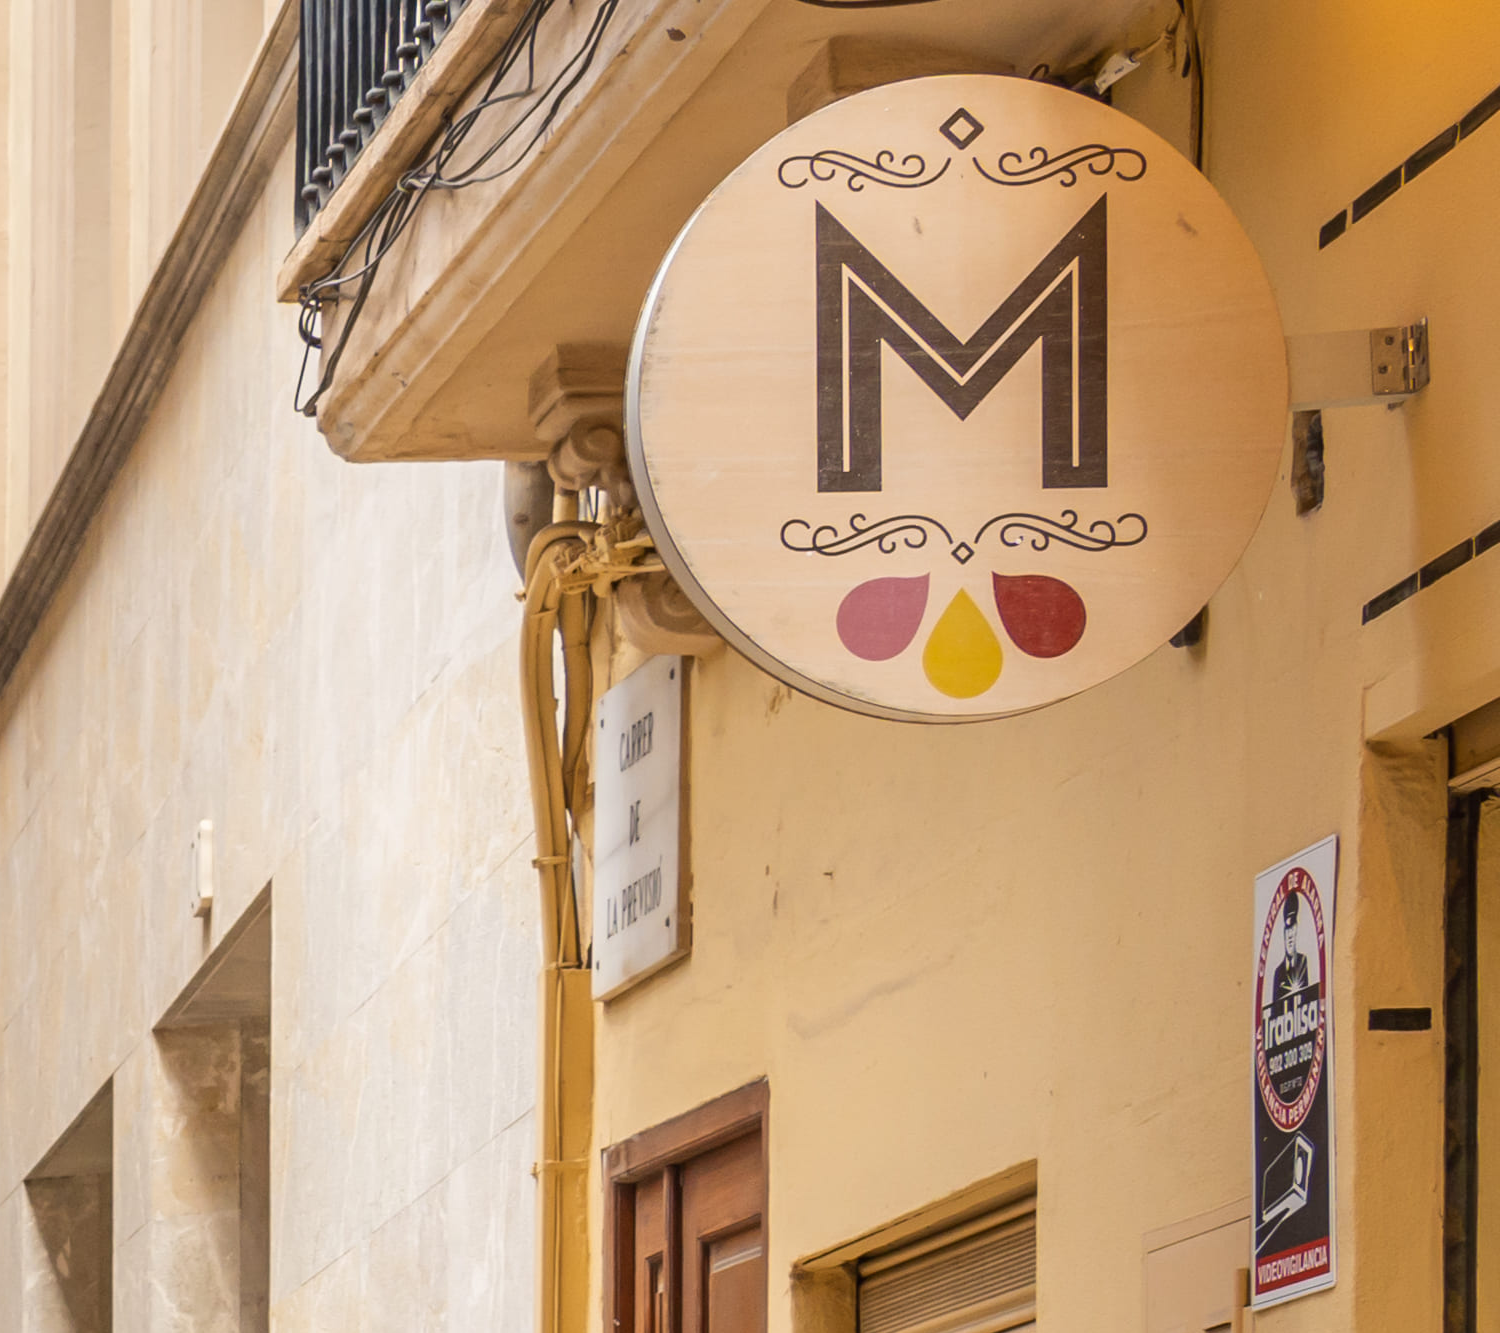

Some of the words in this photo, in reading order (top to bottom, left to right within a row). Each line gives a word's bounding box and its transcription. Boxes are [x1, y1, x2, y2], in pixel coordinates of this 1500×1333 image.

[816, 192, 1108, 492] M
[619, 711, 654, 773] CARRER
[629, 800, 641, 848] DE
[607, 896, 618, 940] LA
[1263, 995, 1319, 1051] Trablisa
[1284, 1047, 1298, 1069] 300
[1257, 1245, 1329, 1285] VIDEOVIGILANCIA
